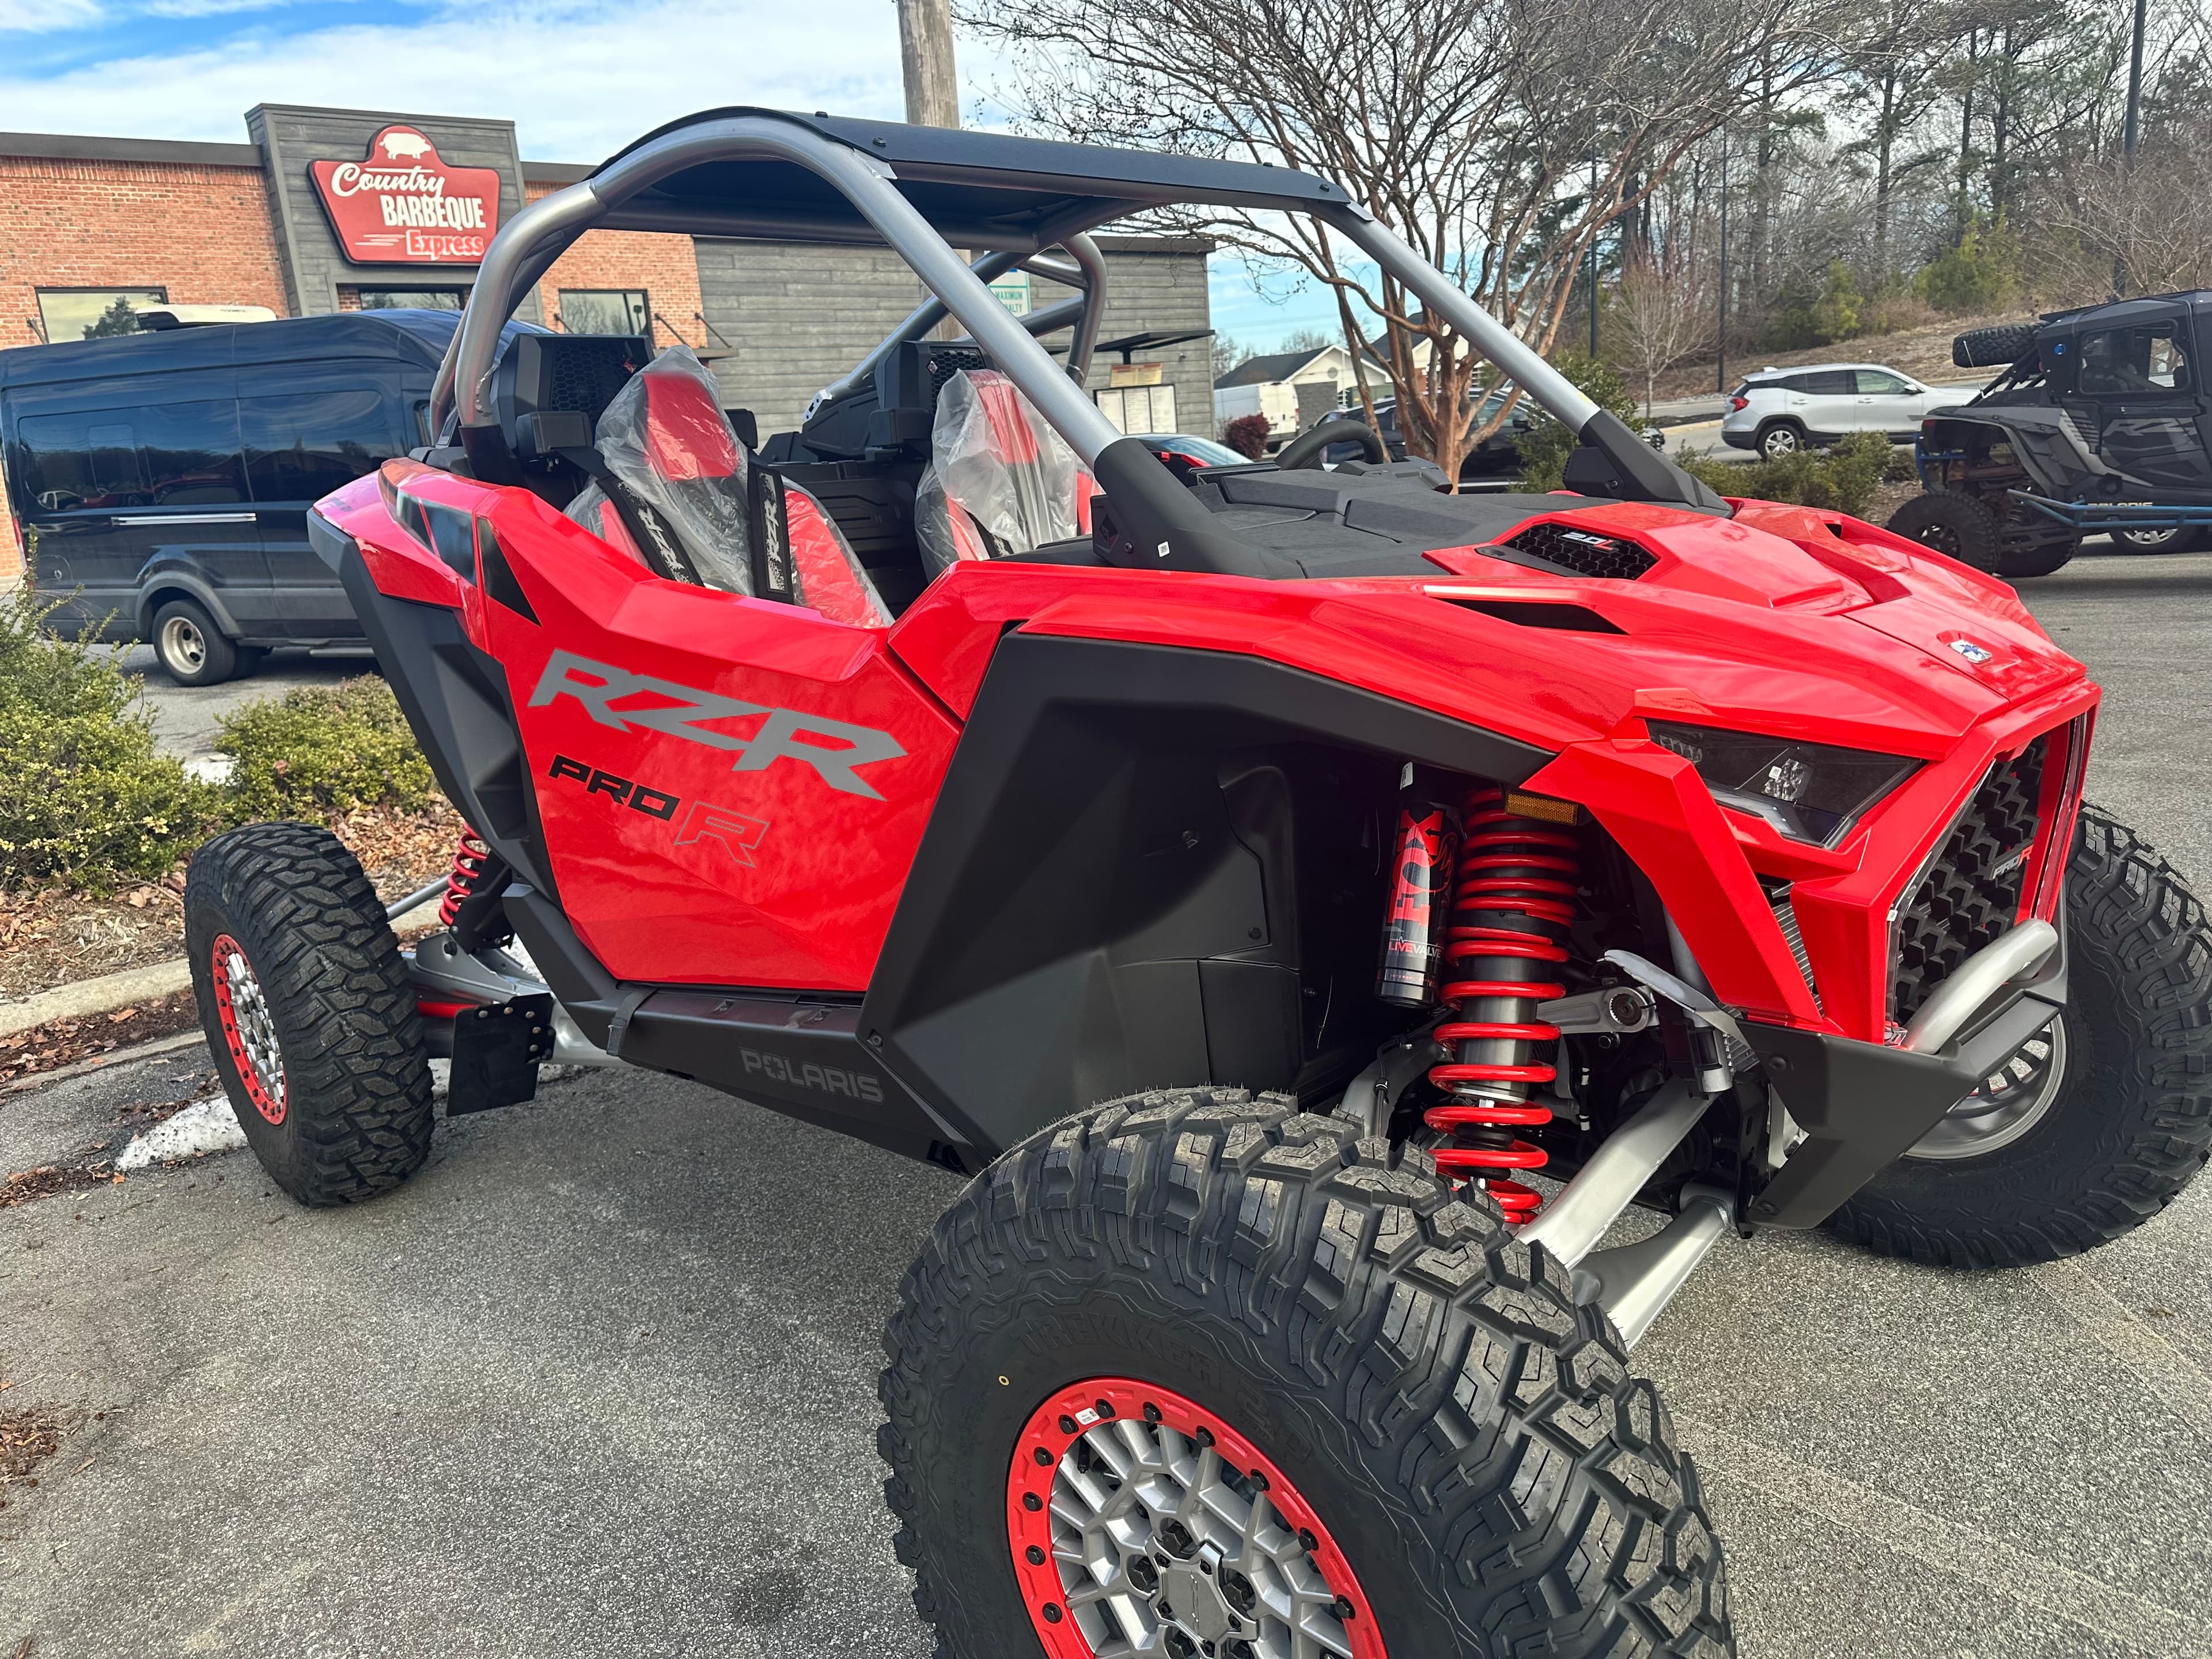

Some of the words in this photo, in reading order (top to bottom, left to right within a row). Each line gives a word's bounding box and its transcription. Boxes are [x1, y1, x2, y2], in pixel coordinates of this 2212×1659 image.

[331, 162, 445, 198] Country
[380, 195, 486, 230] BARBEQUE
[406, 229, 485, 261] Express
[763, 499, 782, 563] RZR
[527, 647, 908, 802] RZR
[548, 753, 681, 821] PRO
[675, 801, 770, 868] R
[1387, 809, 1456, 926] FOX
[739, 1047, 885, 1105] POLARIS
